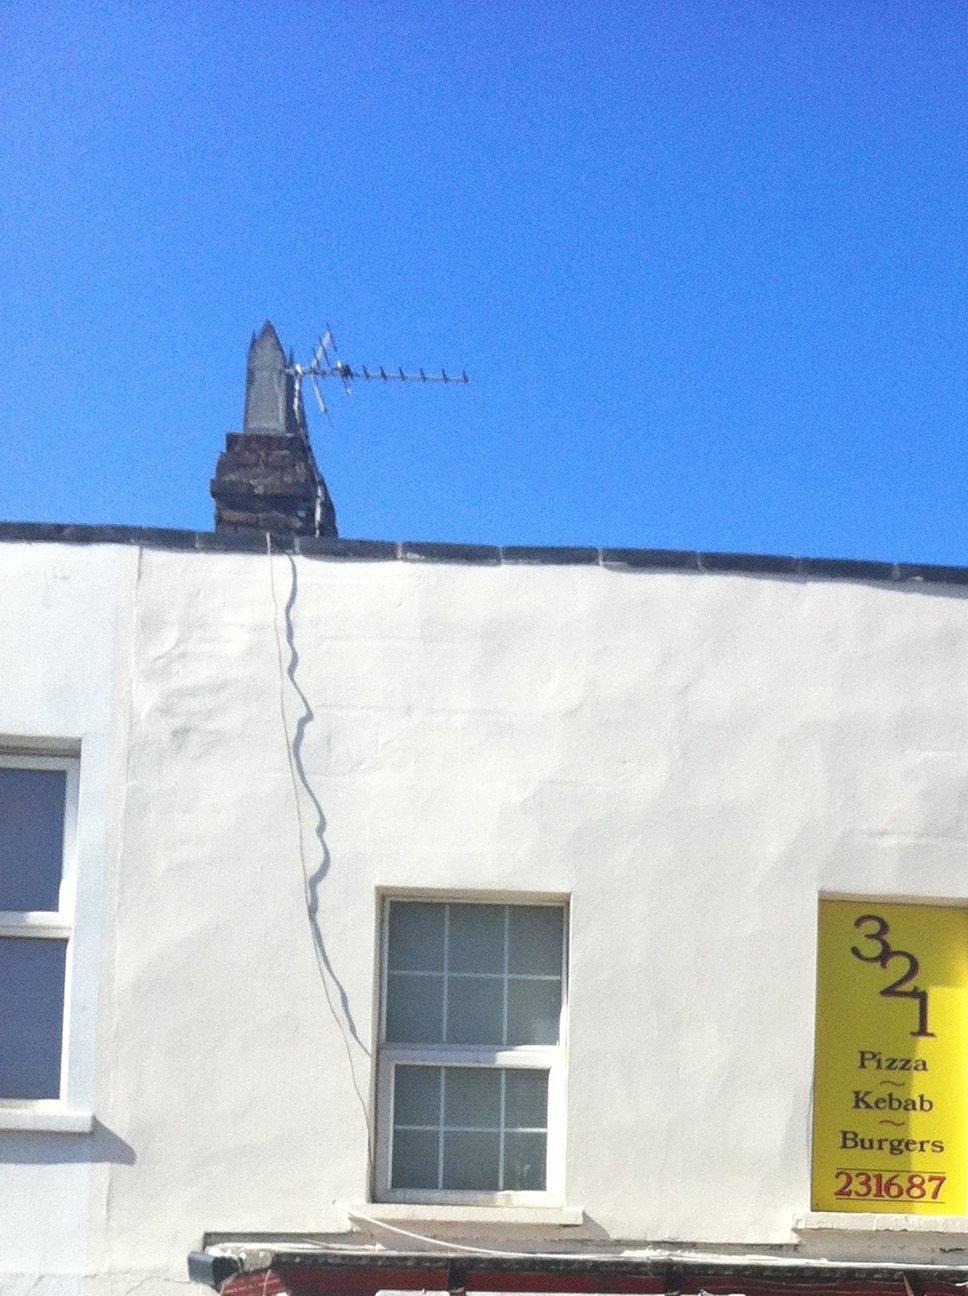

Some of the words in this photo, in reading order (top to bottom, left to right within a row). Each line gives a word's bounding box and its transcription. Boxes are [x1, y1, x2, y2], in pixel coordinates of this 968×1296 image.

[858, 1050, 928, 1072] Pizza
[852, 1090, 933, 1113] Kebab
[839, 1130, 945, 1156] Burgers
[834, 1170, 946, 1200] 231687
